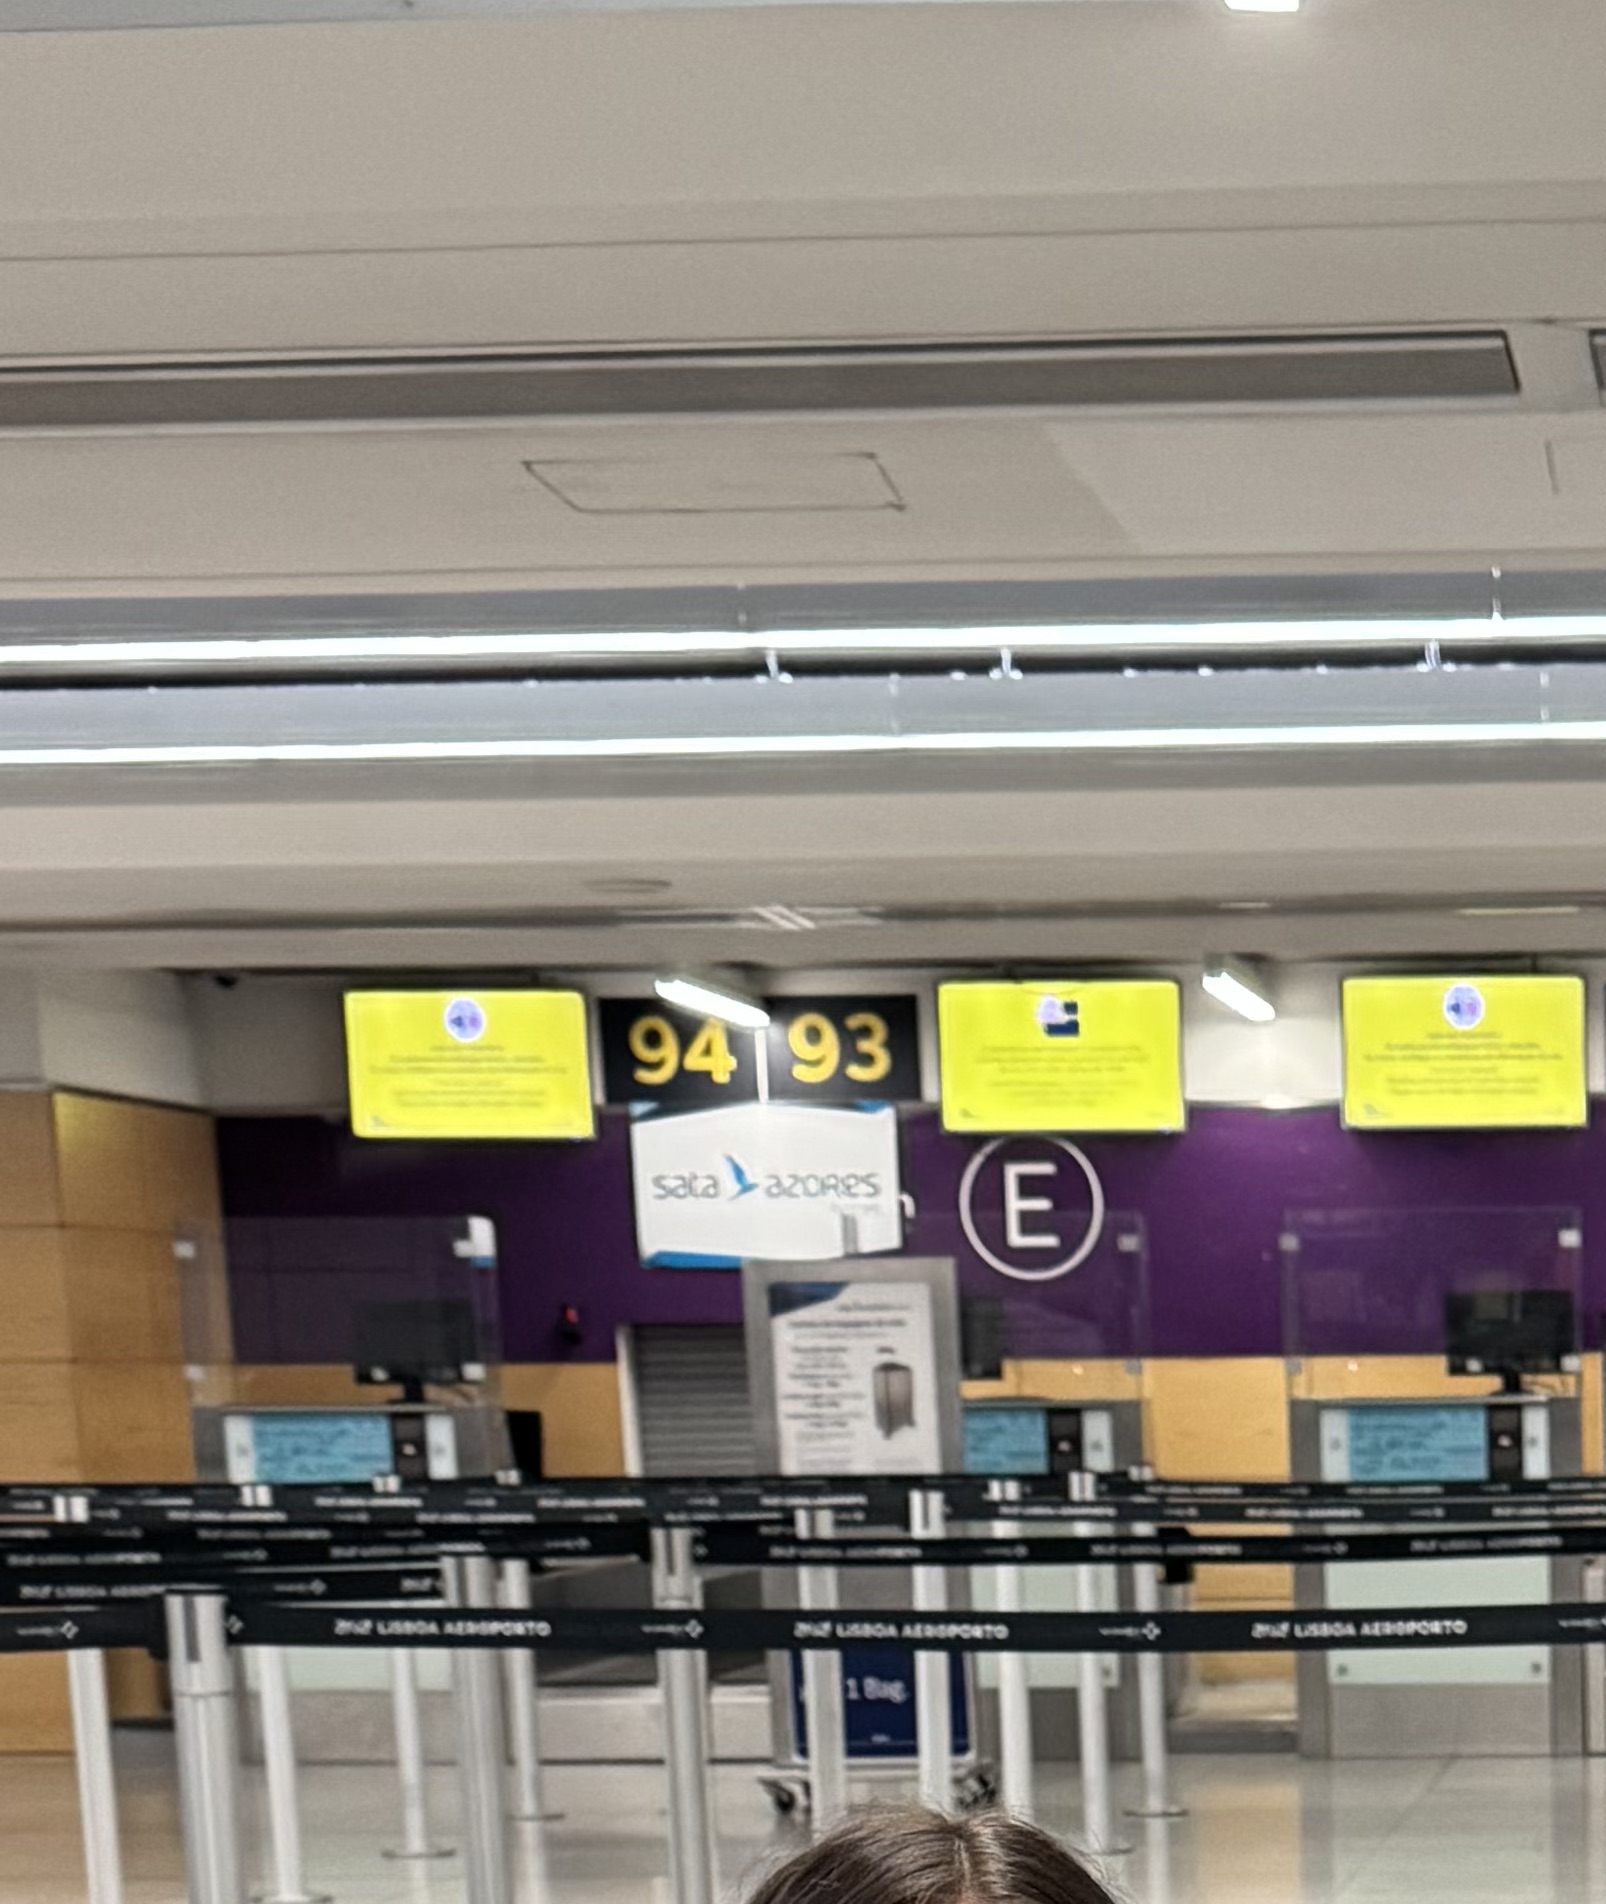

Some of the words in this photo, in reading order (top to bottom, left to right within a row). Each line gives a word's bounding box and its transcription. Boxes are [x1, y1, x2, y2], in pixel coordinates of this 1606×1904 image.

[628, 1015, 737, 1085] 94
[787, 1011, 892, 1083] 93
[652, 1171, 719, 1200] sata
[1003, 1162, 1061, 1248] E
[376, 1620, 440, 1636] LISBOA
[443, 1620, 551, 1637] AEROPORTO
[836, 1621, 899, 1638] LISBOA
[901, 1622, 1009, 1640] AEROPORTO
[1294, 1620, 1356, 1638] LISBOA
[1360, 1619, 1468, 1637] AEROPORTO
